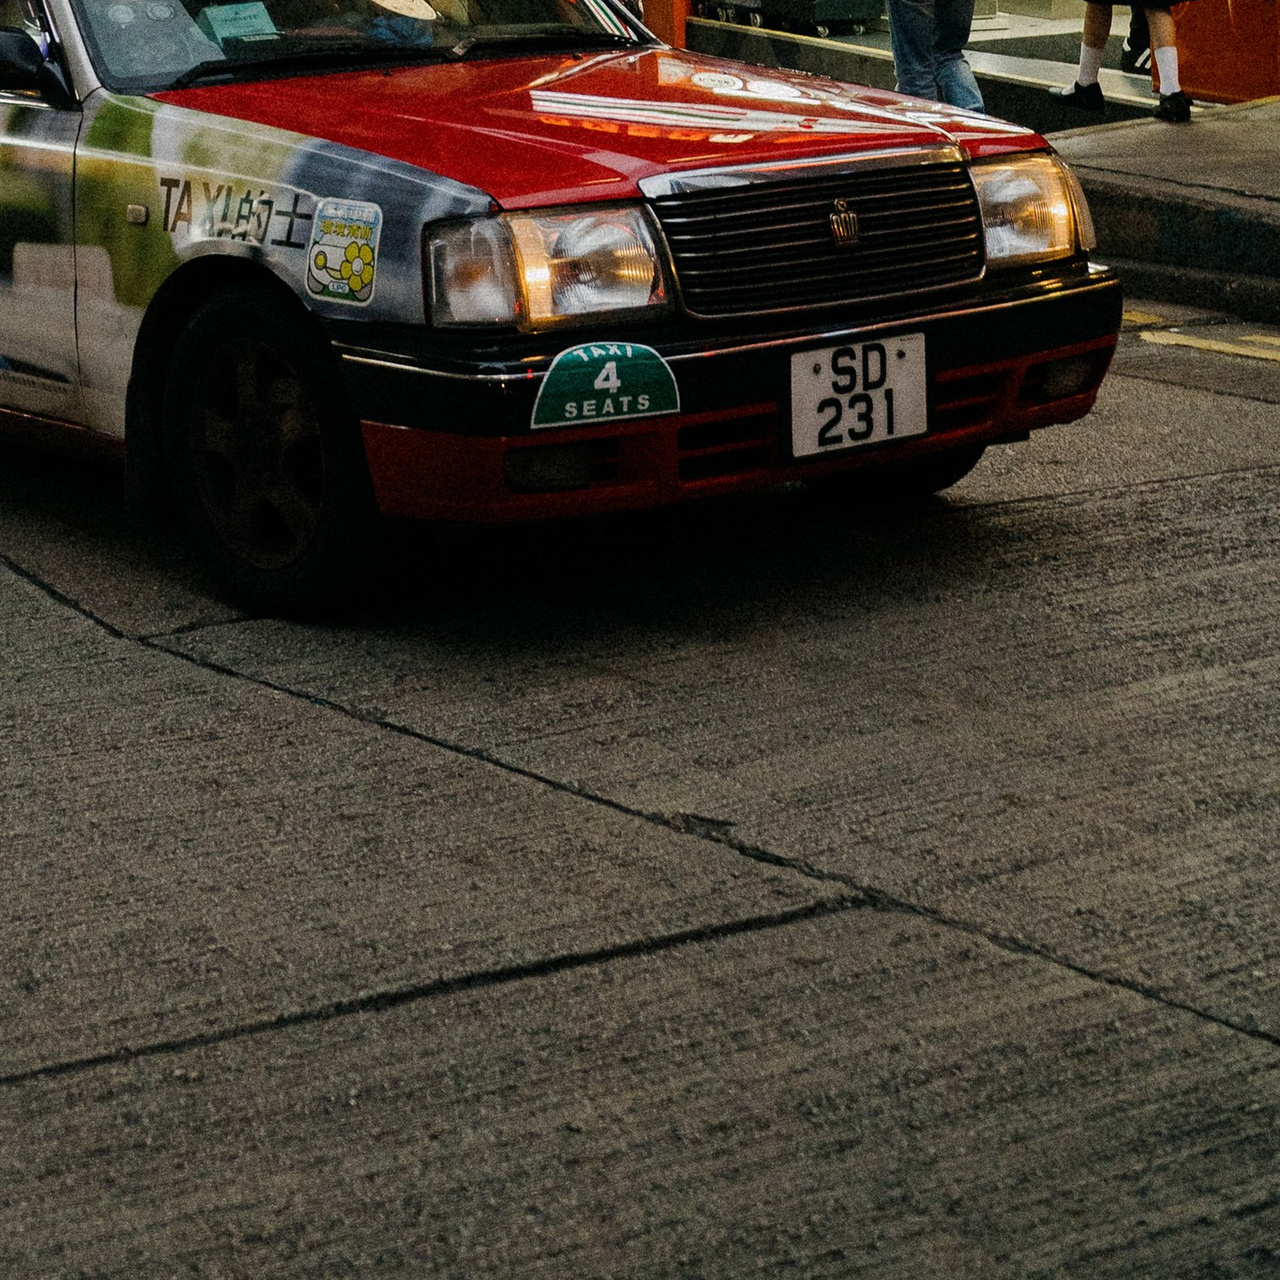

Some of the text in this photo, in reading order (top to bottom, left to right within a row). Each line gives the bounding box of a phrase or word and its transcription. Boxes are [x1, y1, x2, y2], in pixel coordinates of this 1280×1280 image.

[572, 342, 634, 362] TAXI
[593, 361, 622, 394] 4
[831, 343, 888, 395] SD
[564, 394, 651, 419] SEATS
[816, 388, 896, 447] 231
